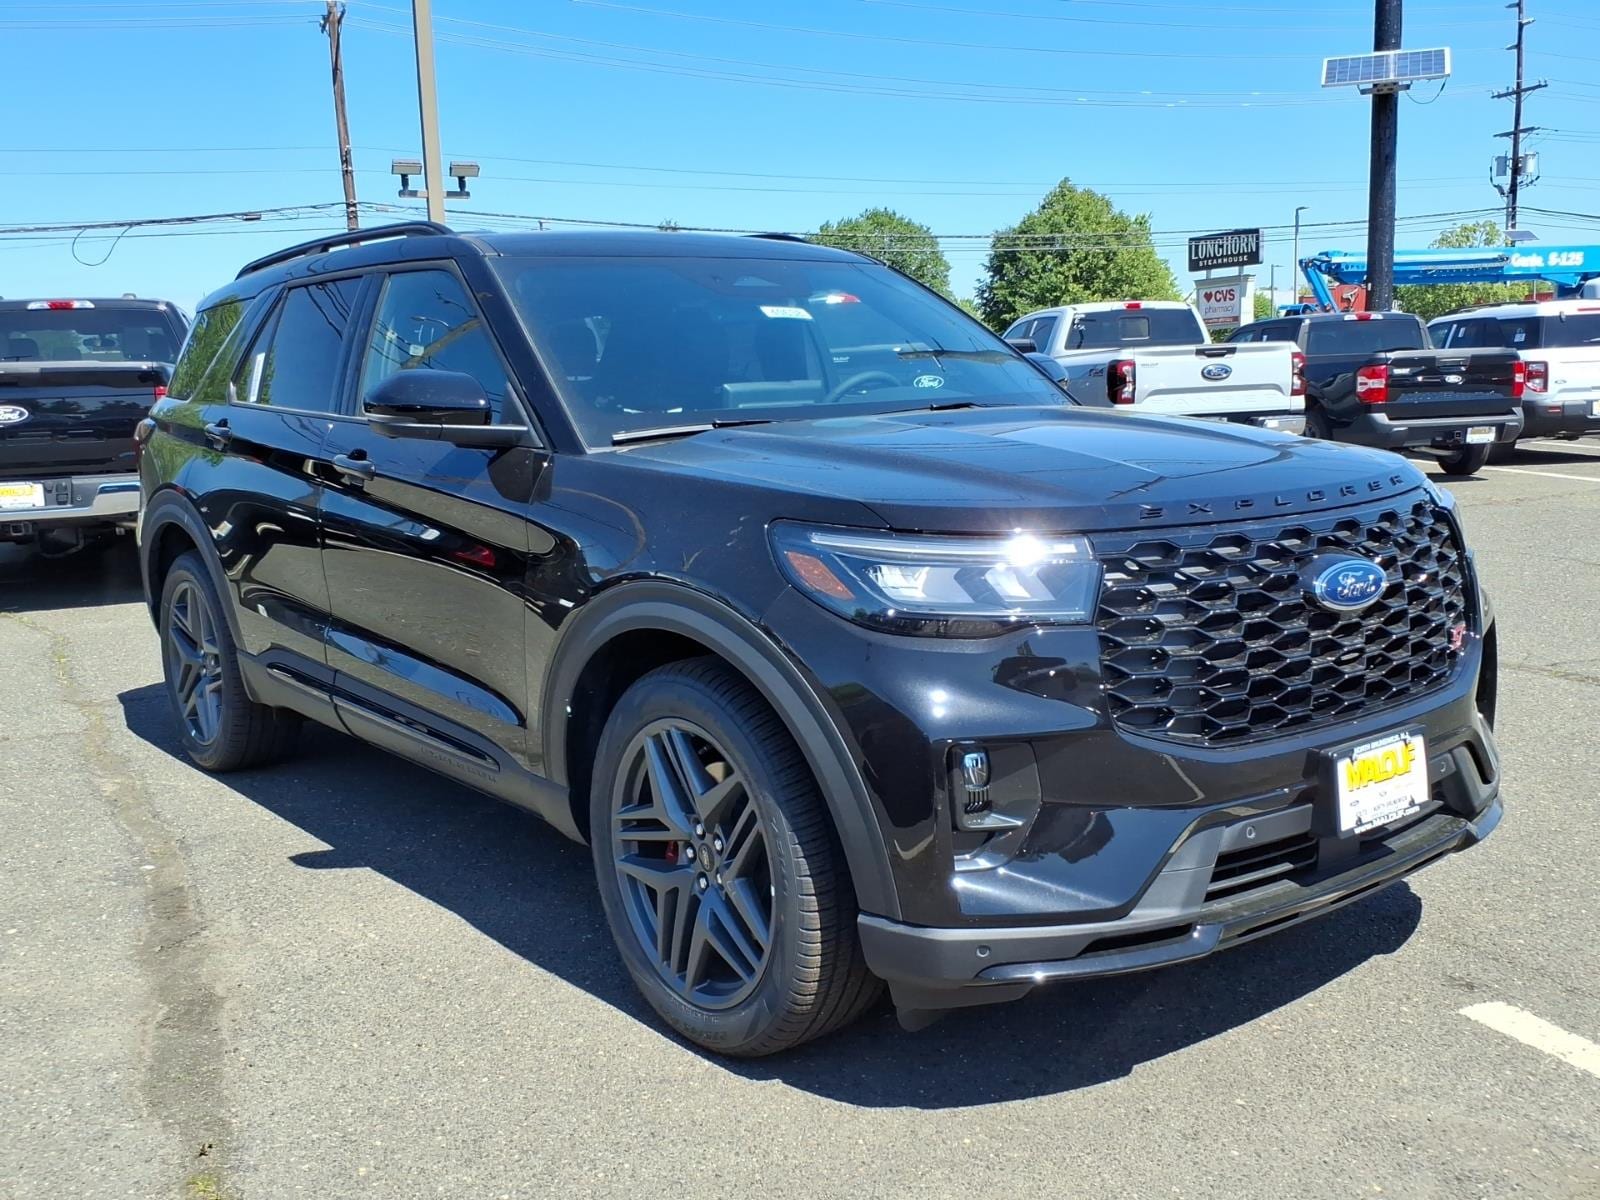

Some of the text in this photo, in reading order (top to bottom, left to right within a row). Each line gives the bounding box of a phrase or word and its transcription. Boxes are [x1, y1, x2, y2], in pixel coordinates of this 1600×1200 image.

[1191, 234, 1257, 260] LONGHORN
[1199, 255, 1249, 267] STEAKHOUSE
[1214, 288, 1236, 302] CVS
[1204, 303, 1235, 316] pharmacy
[1139, 474, 1404, 520] EXPLORER
[1337, 570, 1376, 600] Ford
[1345, 742, 1416, 792] MALOUF
